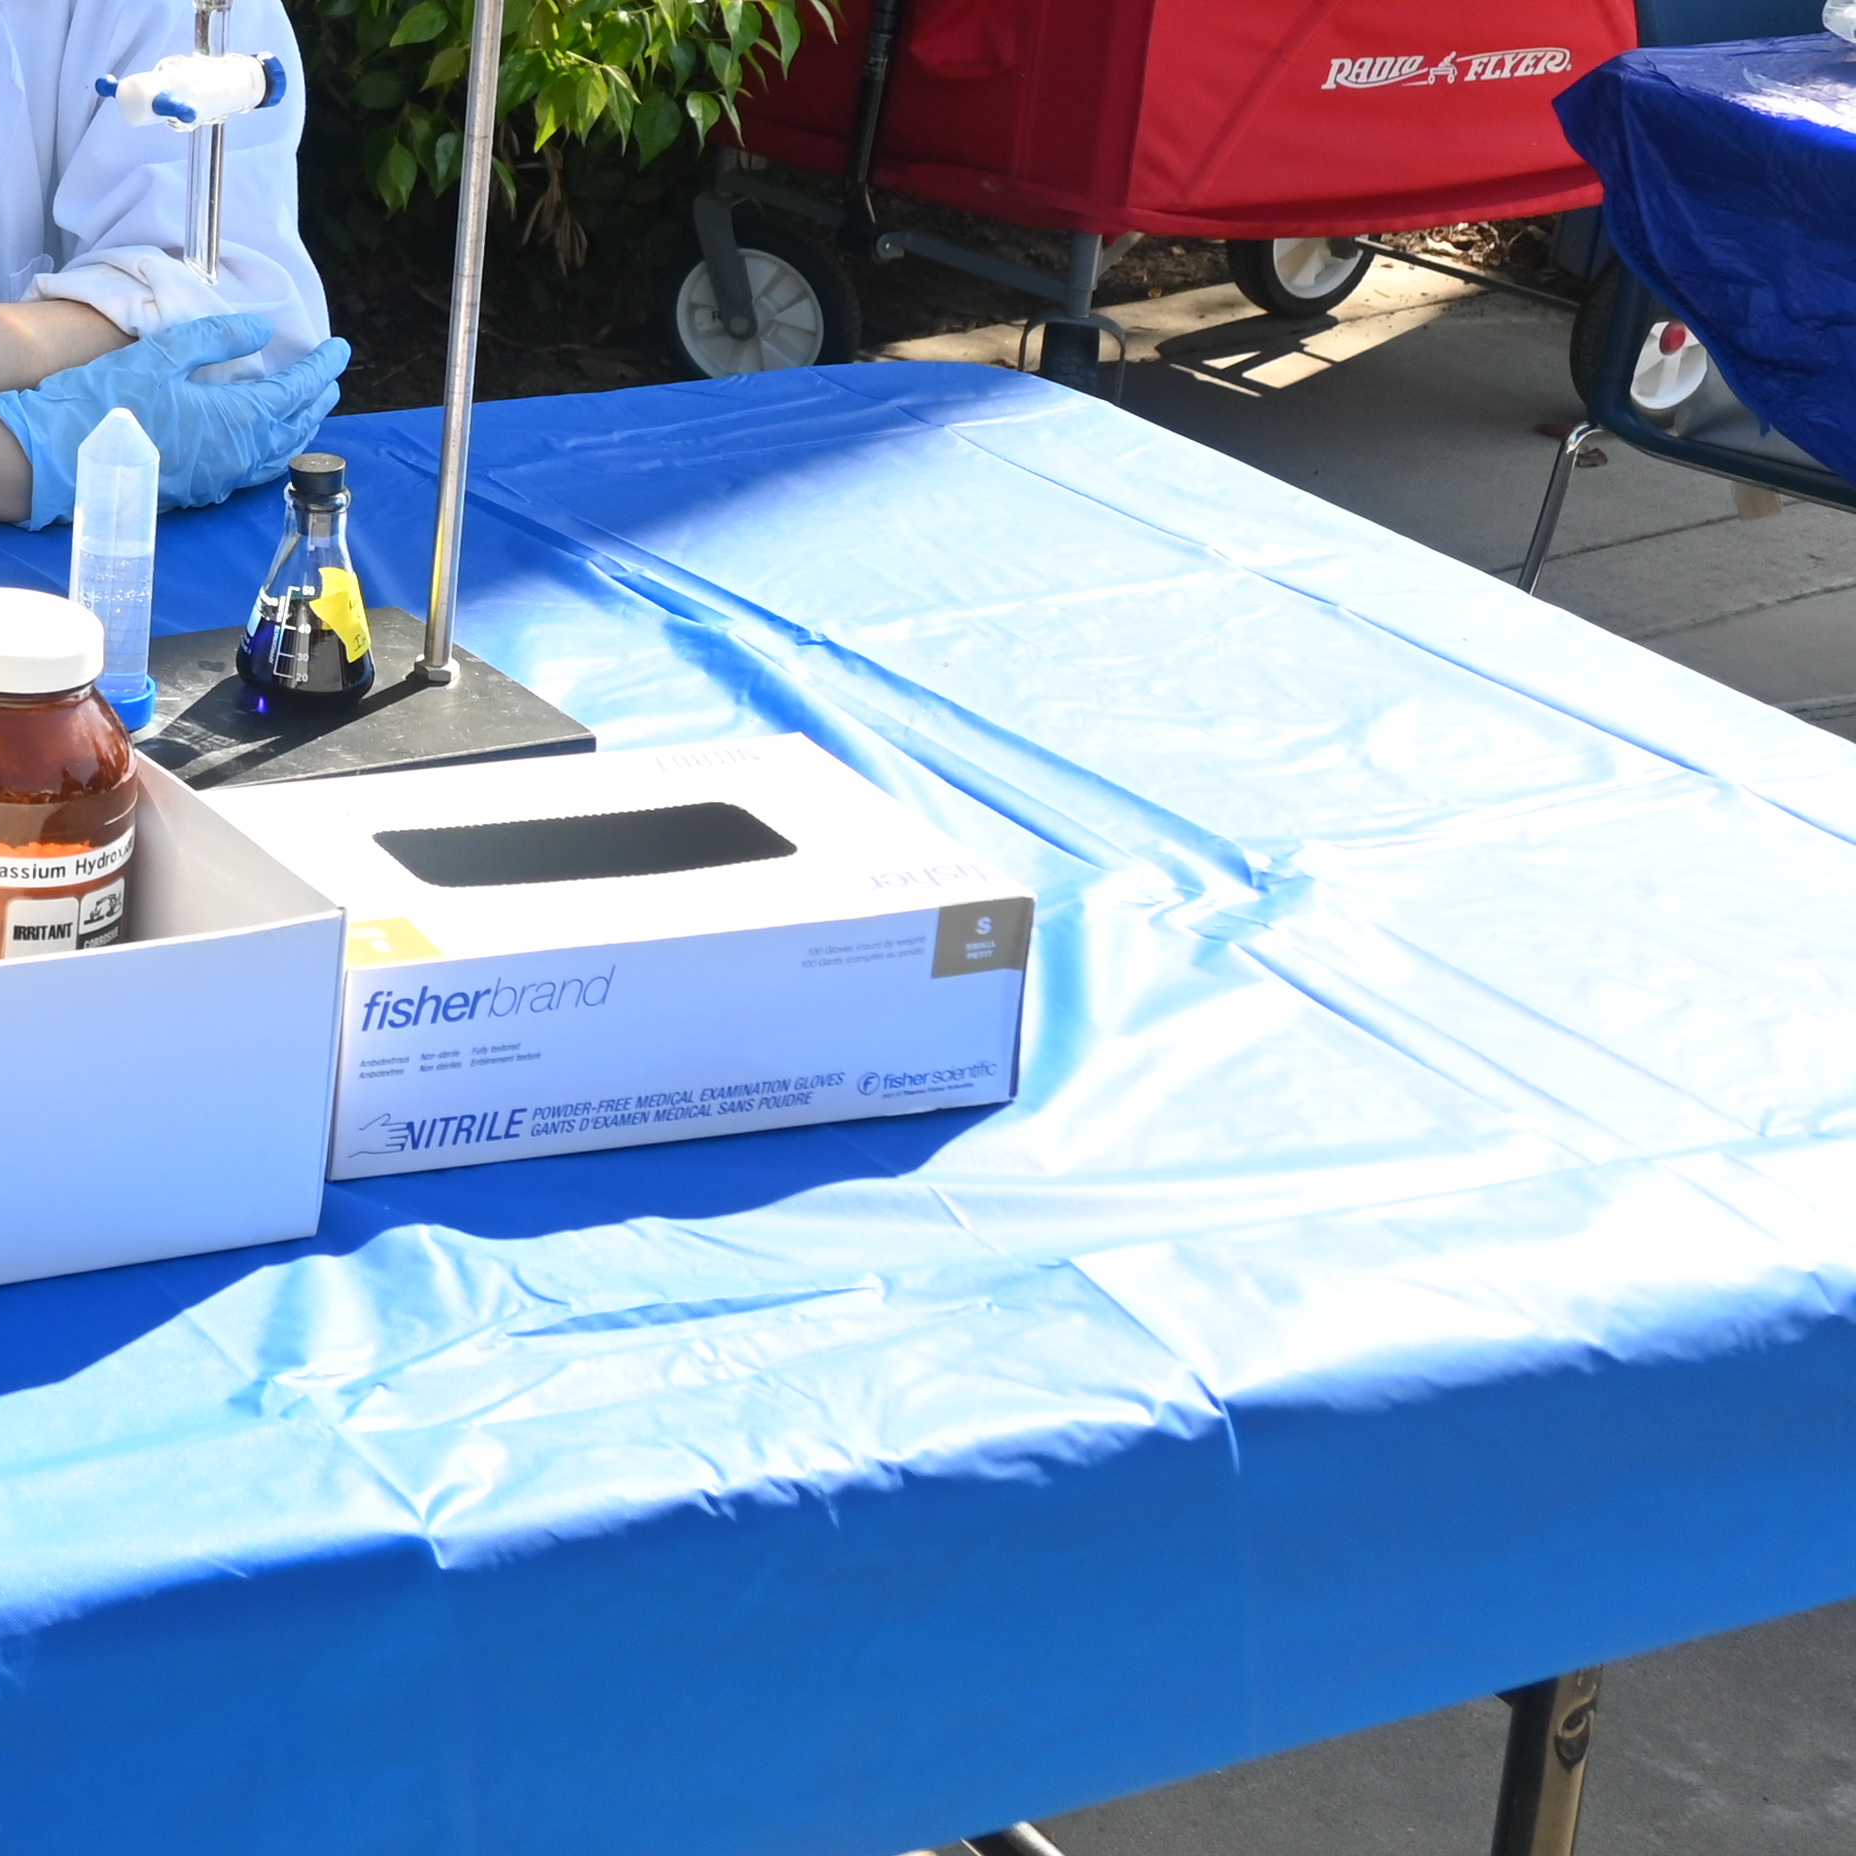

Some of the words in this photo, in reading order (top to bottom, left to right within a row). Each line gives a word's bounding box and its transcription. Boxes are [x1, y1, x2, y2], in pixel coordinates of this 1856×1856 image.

[1321, 55, 1429, 89] RADIO
[1462, 48, 1573, 83] FLYER
[297, 623, 312, 635] 40
[297, 652, 309, 662] 30
[296, 672, 309, 683] 20
[13, 921, 75, 942] IRRITANT
[976, 916, 993, 935] S
[361, 964, 617, 1032] fisherbrand
[882, 1070, 932, 1090] fisher
[932, 1061, 999, 1084] scientific
[531, 1096, 632, 1122] POWDER-FREE
[636, 1089, 695, 1110] MEDICAL
[699, 1078, 792, 1103] EXAMINATION
[794, 1071, 846, 1091] GLOVES
[530, 1118, 576, 1138] GANTS
[578, 1109, 652, 1132] D'EXAMEN
[717, 1098, 756, 1116] SANS
[757, 1090, 815, 1111] POUDRE
[402, 1107, 528, 1151] NITRILE
